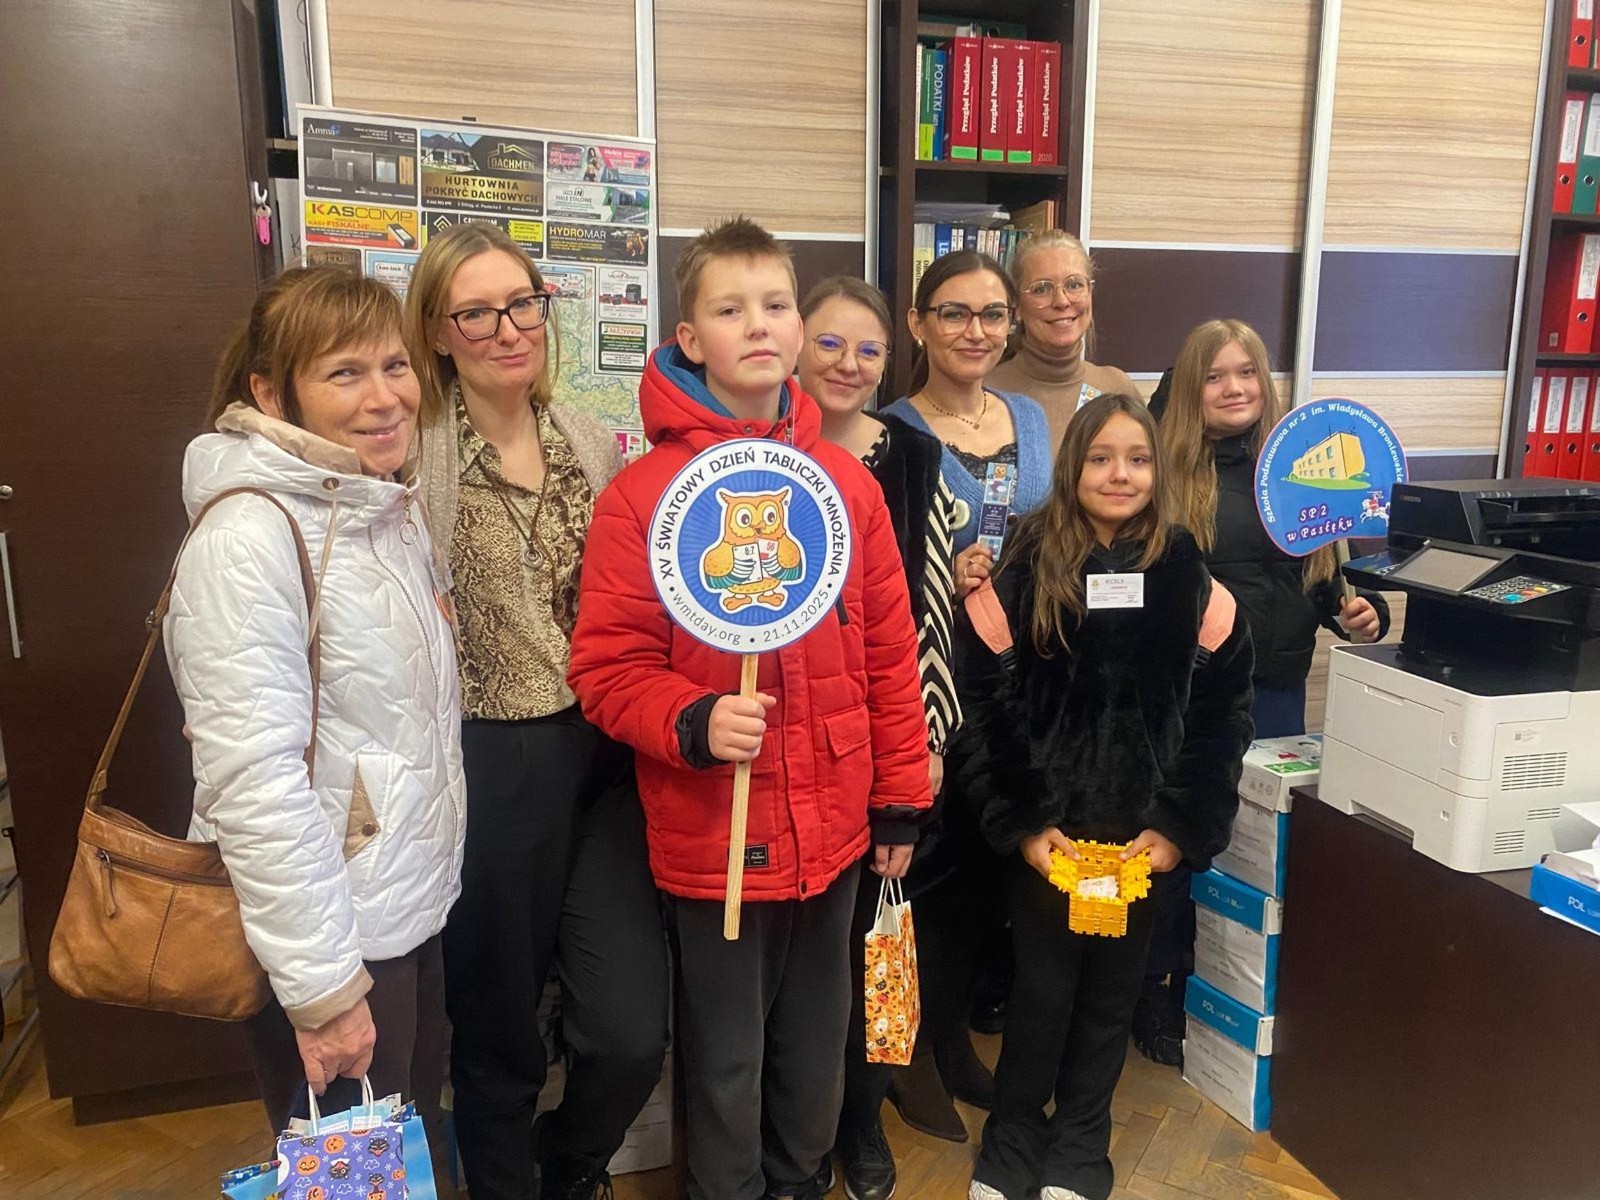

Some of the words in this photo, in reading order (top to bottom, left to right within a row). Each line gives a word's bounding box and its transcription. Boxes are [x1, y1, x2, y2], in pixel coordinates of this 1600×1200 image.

[932, 64, 944, 112] PODATKI
[962, 56, 971, 96] Podatków
[990, 56, 998, 96] Podatków
[1043, 62, 1051, 101] Podatków
[962, 98, 970, 132] Przegląd
[990, 98, 998, 134] Przegląd
[1016, 100, 1024, 134] Przegląd
[1042, 103, 1050, 137] Przegląd
[1038, 152, 1052, 162] 2020
[426, 185, 468, 198] POKRYĆ
[471, 190, 539, 203] DACHOWYCH
[445, 176, 519, 190] HURTOWNIA
[312, 204, 412, 222] KASCOMP
[326, 221, 370, 230] FISKALNE
[549, 226, 606, 240] HYDROMAR
[1288, 418, 1298, 429] nr
[1300, 412, 1307, 422] 2
[1312, 407, 1326, 416] im.
[1328, 404, 1378, 428] Władysława
[709, 447, 756, 474] DZIEŃ
[1260, 428, 1288, 487] Podstawowa
[763, 450, 826, 494] TABLICZKI
[656, 468, 705, 550] ŚWIATOWY
[1260, 490, 1276, 524] Szkoła
[1300, 507, 1317, 522] SP
[1320, 506, 1328, 516] 2
[823, 496, 844, 576] MNOŻENIA
[1286, 532, 1297, 542] w
[1300, 518, 1353, 537] Pasłęku
[659, 558, 674, 580] XV
[673, 592, 740, 645] wmtday.org
[764, 590, 828, 642] 21.11.2025
[1208, 886, 1220, 899] POL
[1568, 896, 1586, 912] POL
[1202, 1000, 1215, 1014] POL
